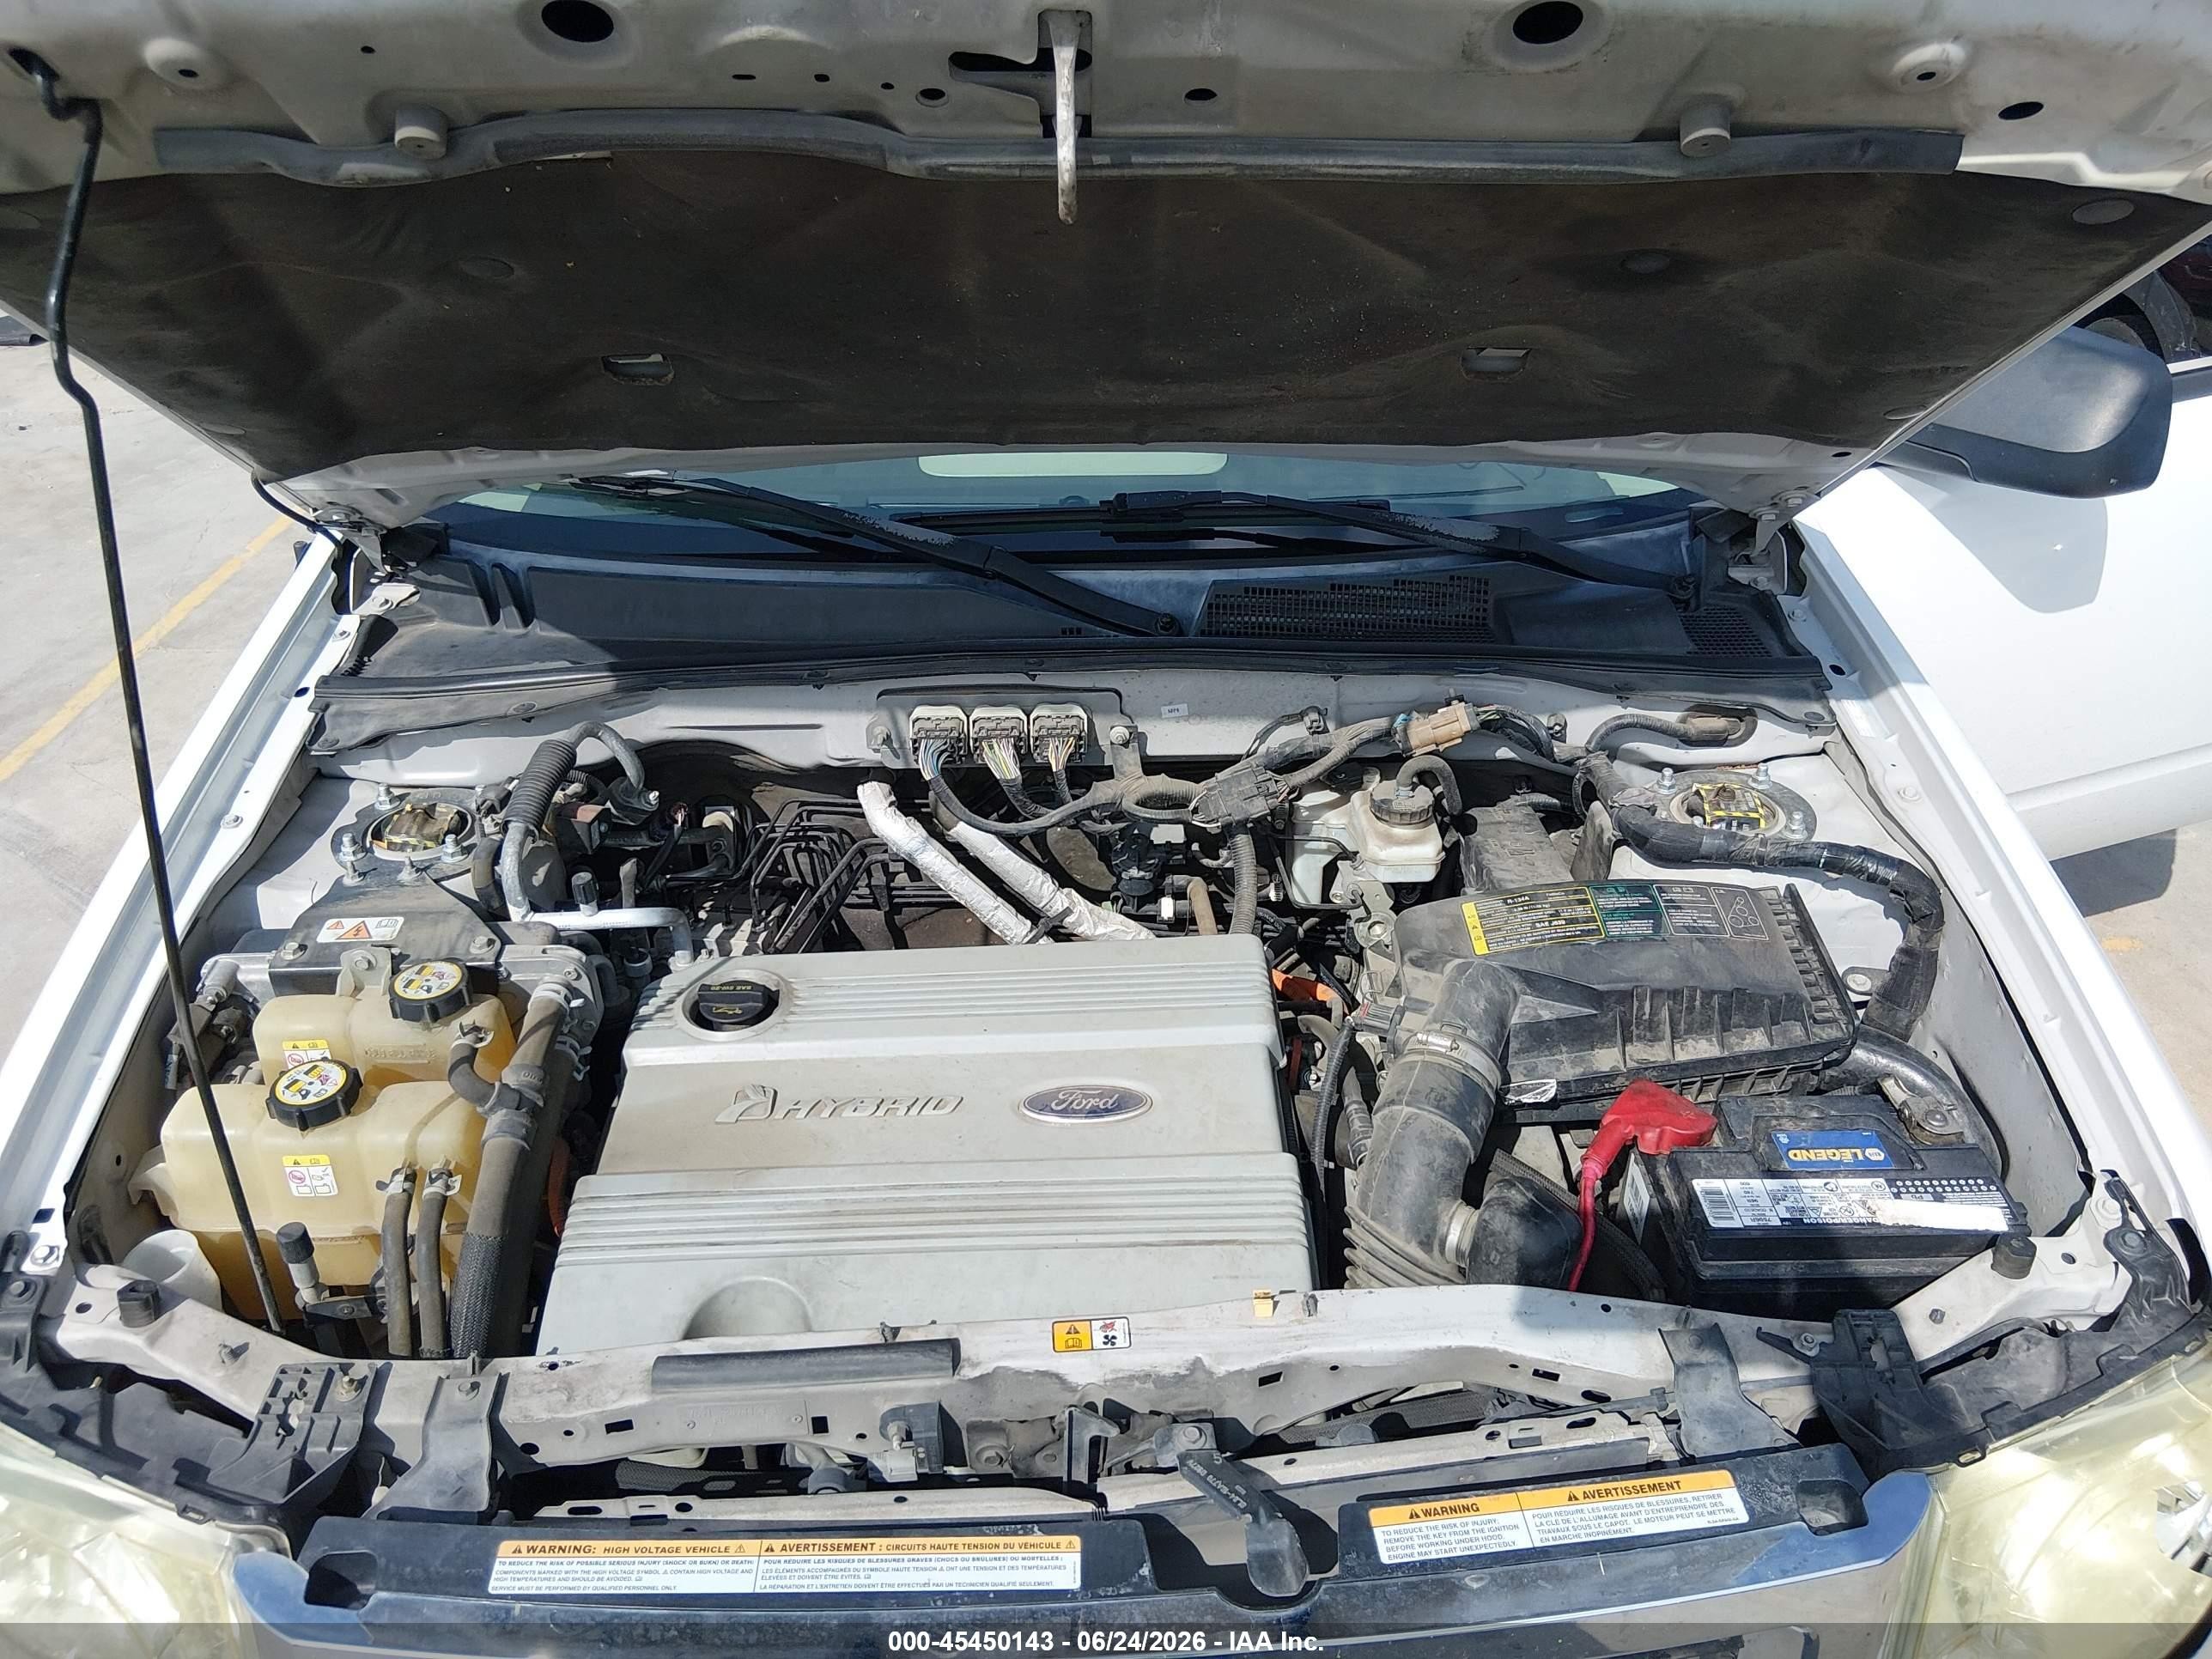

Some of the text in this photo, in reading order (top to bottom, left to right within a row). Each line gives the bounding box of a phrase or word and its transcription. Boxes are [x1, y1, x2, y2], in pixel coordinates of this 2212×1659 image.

[783, 1095, 965, 1119] HYBRID
[1050, 1090, 1118, 1112] Ford
[1788, 1148, 1864, 1161] LEGEND
[1583, 1480, 1681, 1499] AVERTISSEMENT
[1603, 1503, 1633, 1511] RISQUES
[1692, 1492, 1723, 1501] RETIRER
[1421, 1503, 1480, 1517] WARNING
[1394, 1527, 1423, 1535] REDUCE
[1538, 1526, 1570, 1535] TRAVAUX
[1644, 1515, 1674, 1523] MOTEUR
[1384, 1535, 1414, 1545] REMOVE
[1552, 1533, 1583, 1541] MARCHE
[526, 1545, 596, 1554] WARNING:
[780, 1543, 876, 1552] AVERTISSEMENT
[1386, 1543, 1416, 1553] BEFORE
[1418, 1539, 1453, 1548] WORKING
[1389, 1551, 1415, 1560] ENGINE
[1435, 1547, 1457, 1555] START
